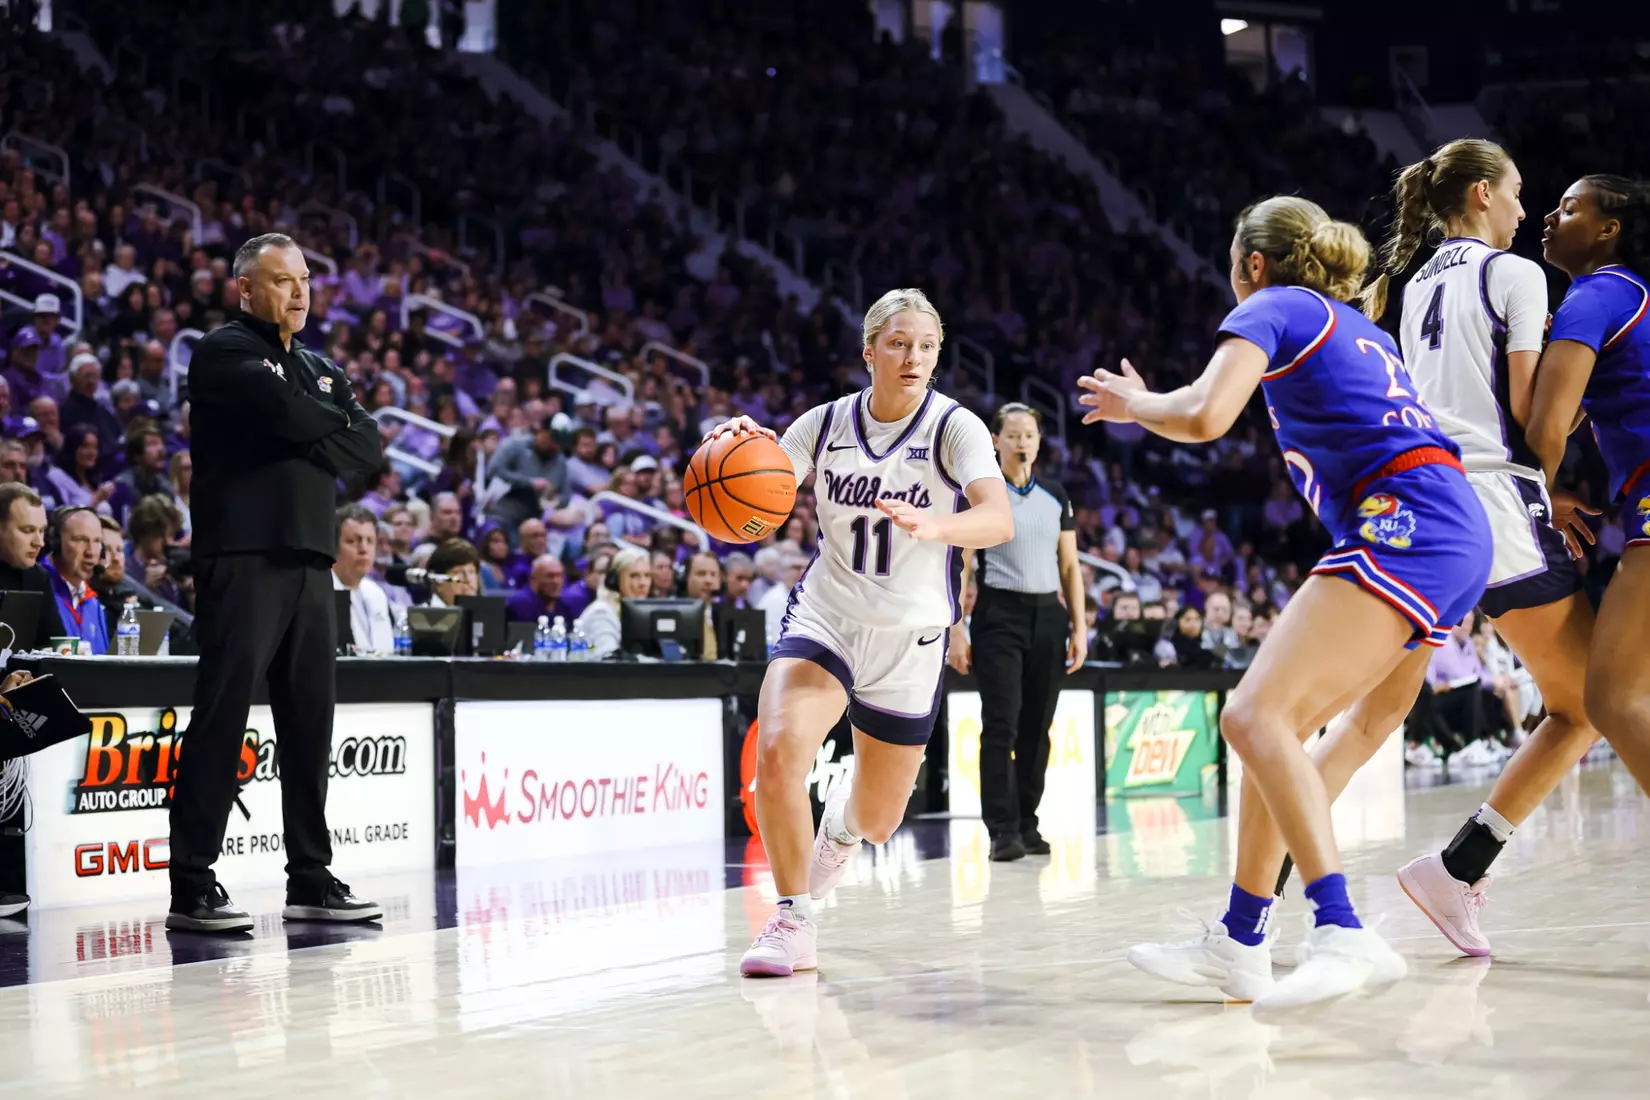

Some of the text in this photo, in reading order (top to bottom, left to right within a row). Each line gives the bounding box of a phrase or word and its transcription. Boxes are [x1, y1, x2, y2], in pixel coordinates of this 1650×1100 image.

[1416, 246, 1472, 283] SUNDELL
[1420, 282, 1444, 351] 4
[907, 446, 929, 461] XII
[824, 469, 933, 509] Wildcats
[850, 515, 893, 576] 11
[79, 787, 167, 811] AUTO GROUP
[518, 769, 649, 824] SMOOTHIE
[364, 822, 409, 843] GRADE
[75, 838, 170, 877] GMC
